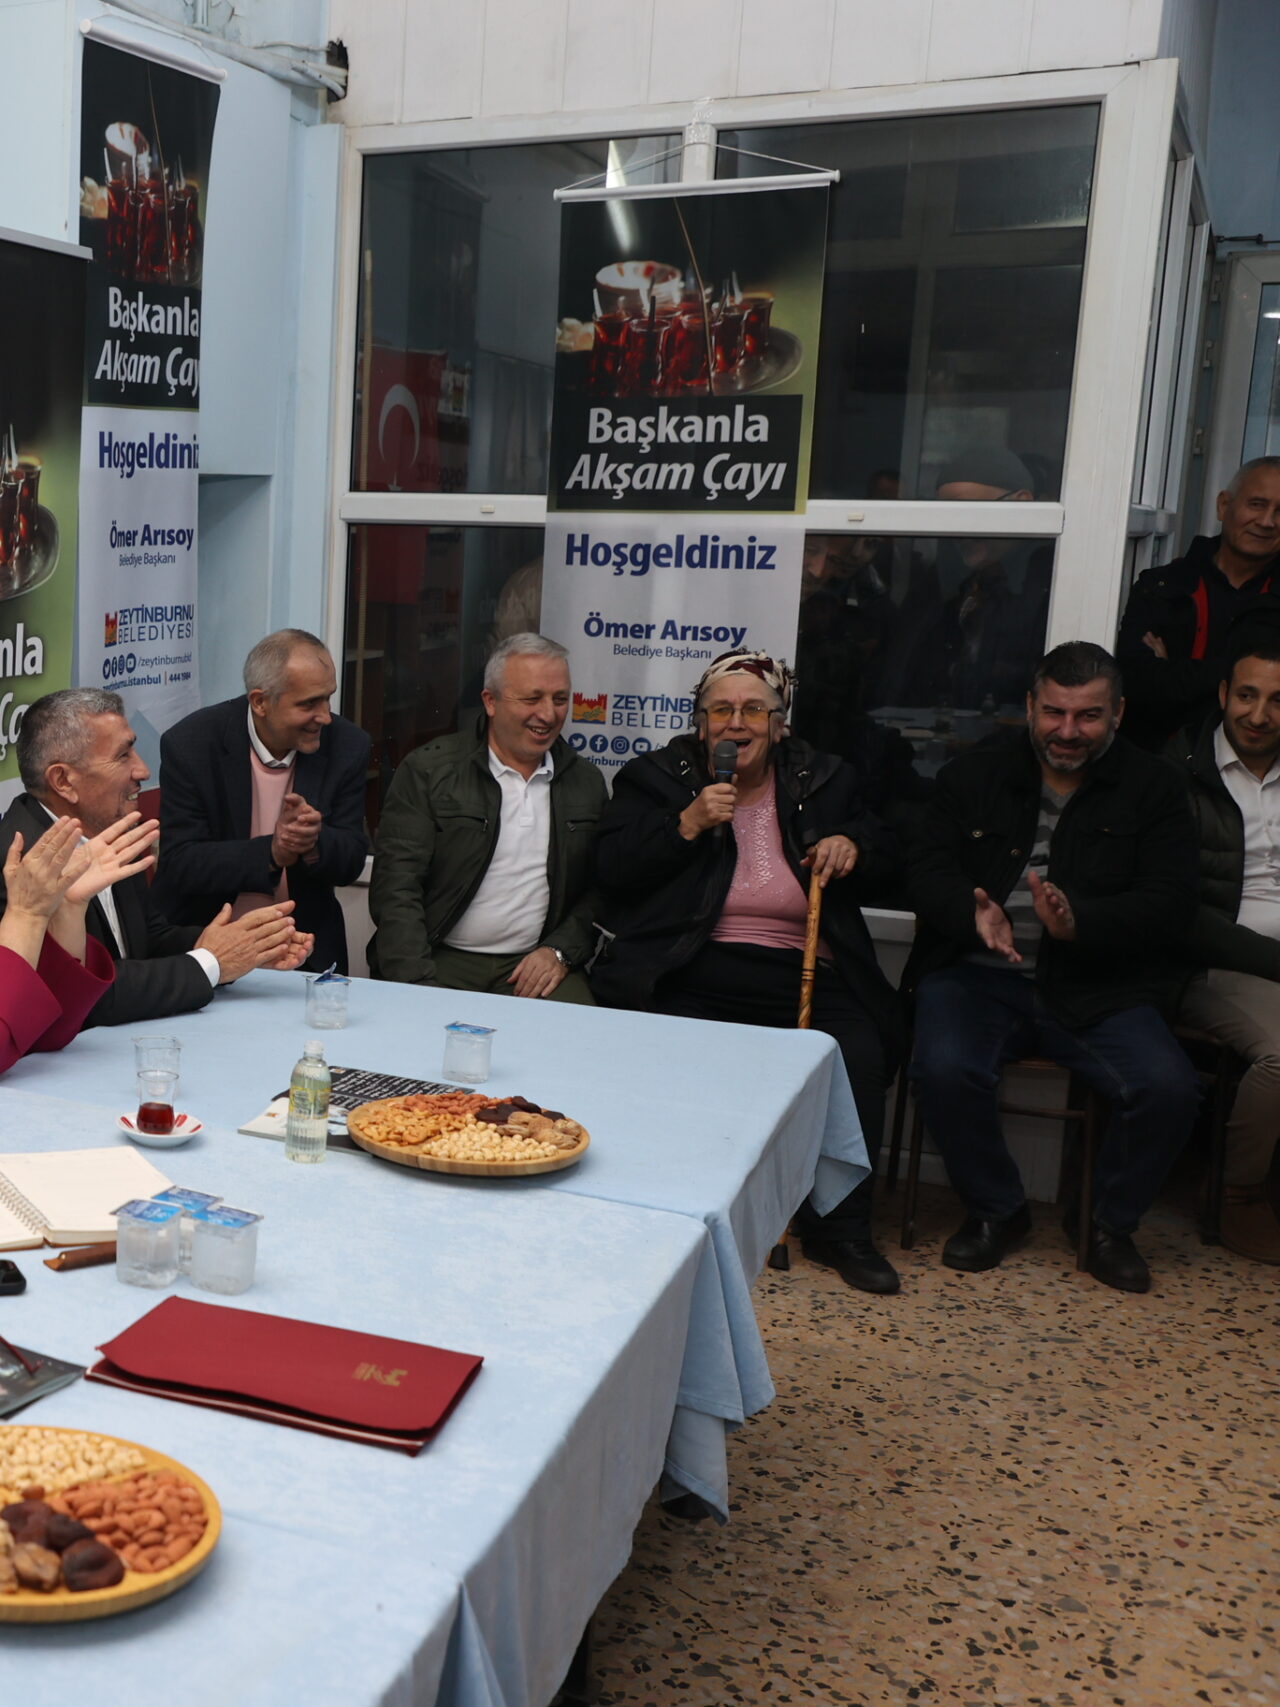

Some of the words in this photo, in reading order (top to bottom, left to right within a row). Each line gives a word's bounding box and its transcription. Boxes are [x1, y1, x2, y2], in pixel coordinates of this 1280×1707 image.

[108, 286, 200, 343] Başkanla
[94, 339, 161, 393] Akşam
[165, 346, 200, 398] Çay
[587, 404, 770, 454] Başkanla
[564, 452, 696, 500] Akşam
[702, 452, 788, 501] Çayı
[109, 520, 138, 549] Ömer
[140, 524, 194, 551] Arısoy
[143, 552, 176, 568] Başkanı
[565, 533, 778, 577] Hoşgeldiniz
[118, 603, 195, 627] ZEYTİNBURNU
[583, 611, 656, 640] Ömer
[660, 619, 748, 649] Arısoy
[117, 621, 194, 645] BELEDİYESİ
[613, 643, 663, 659] Belediye
[665, 646, 713, 661] Başkanı
[612, 693, 695, 713] ZEYTİNB
